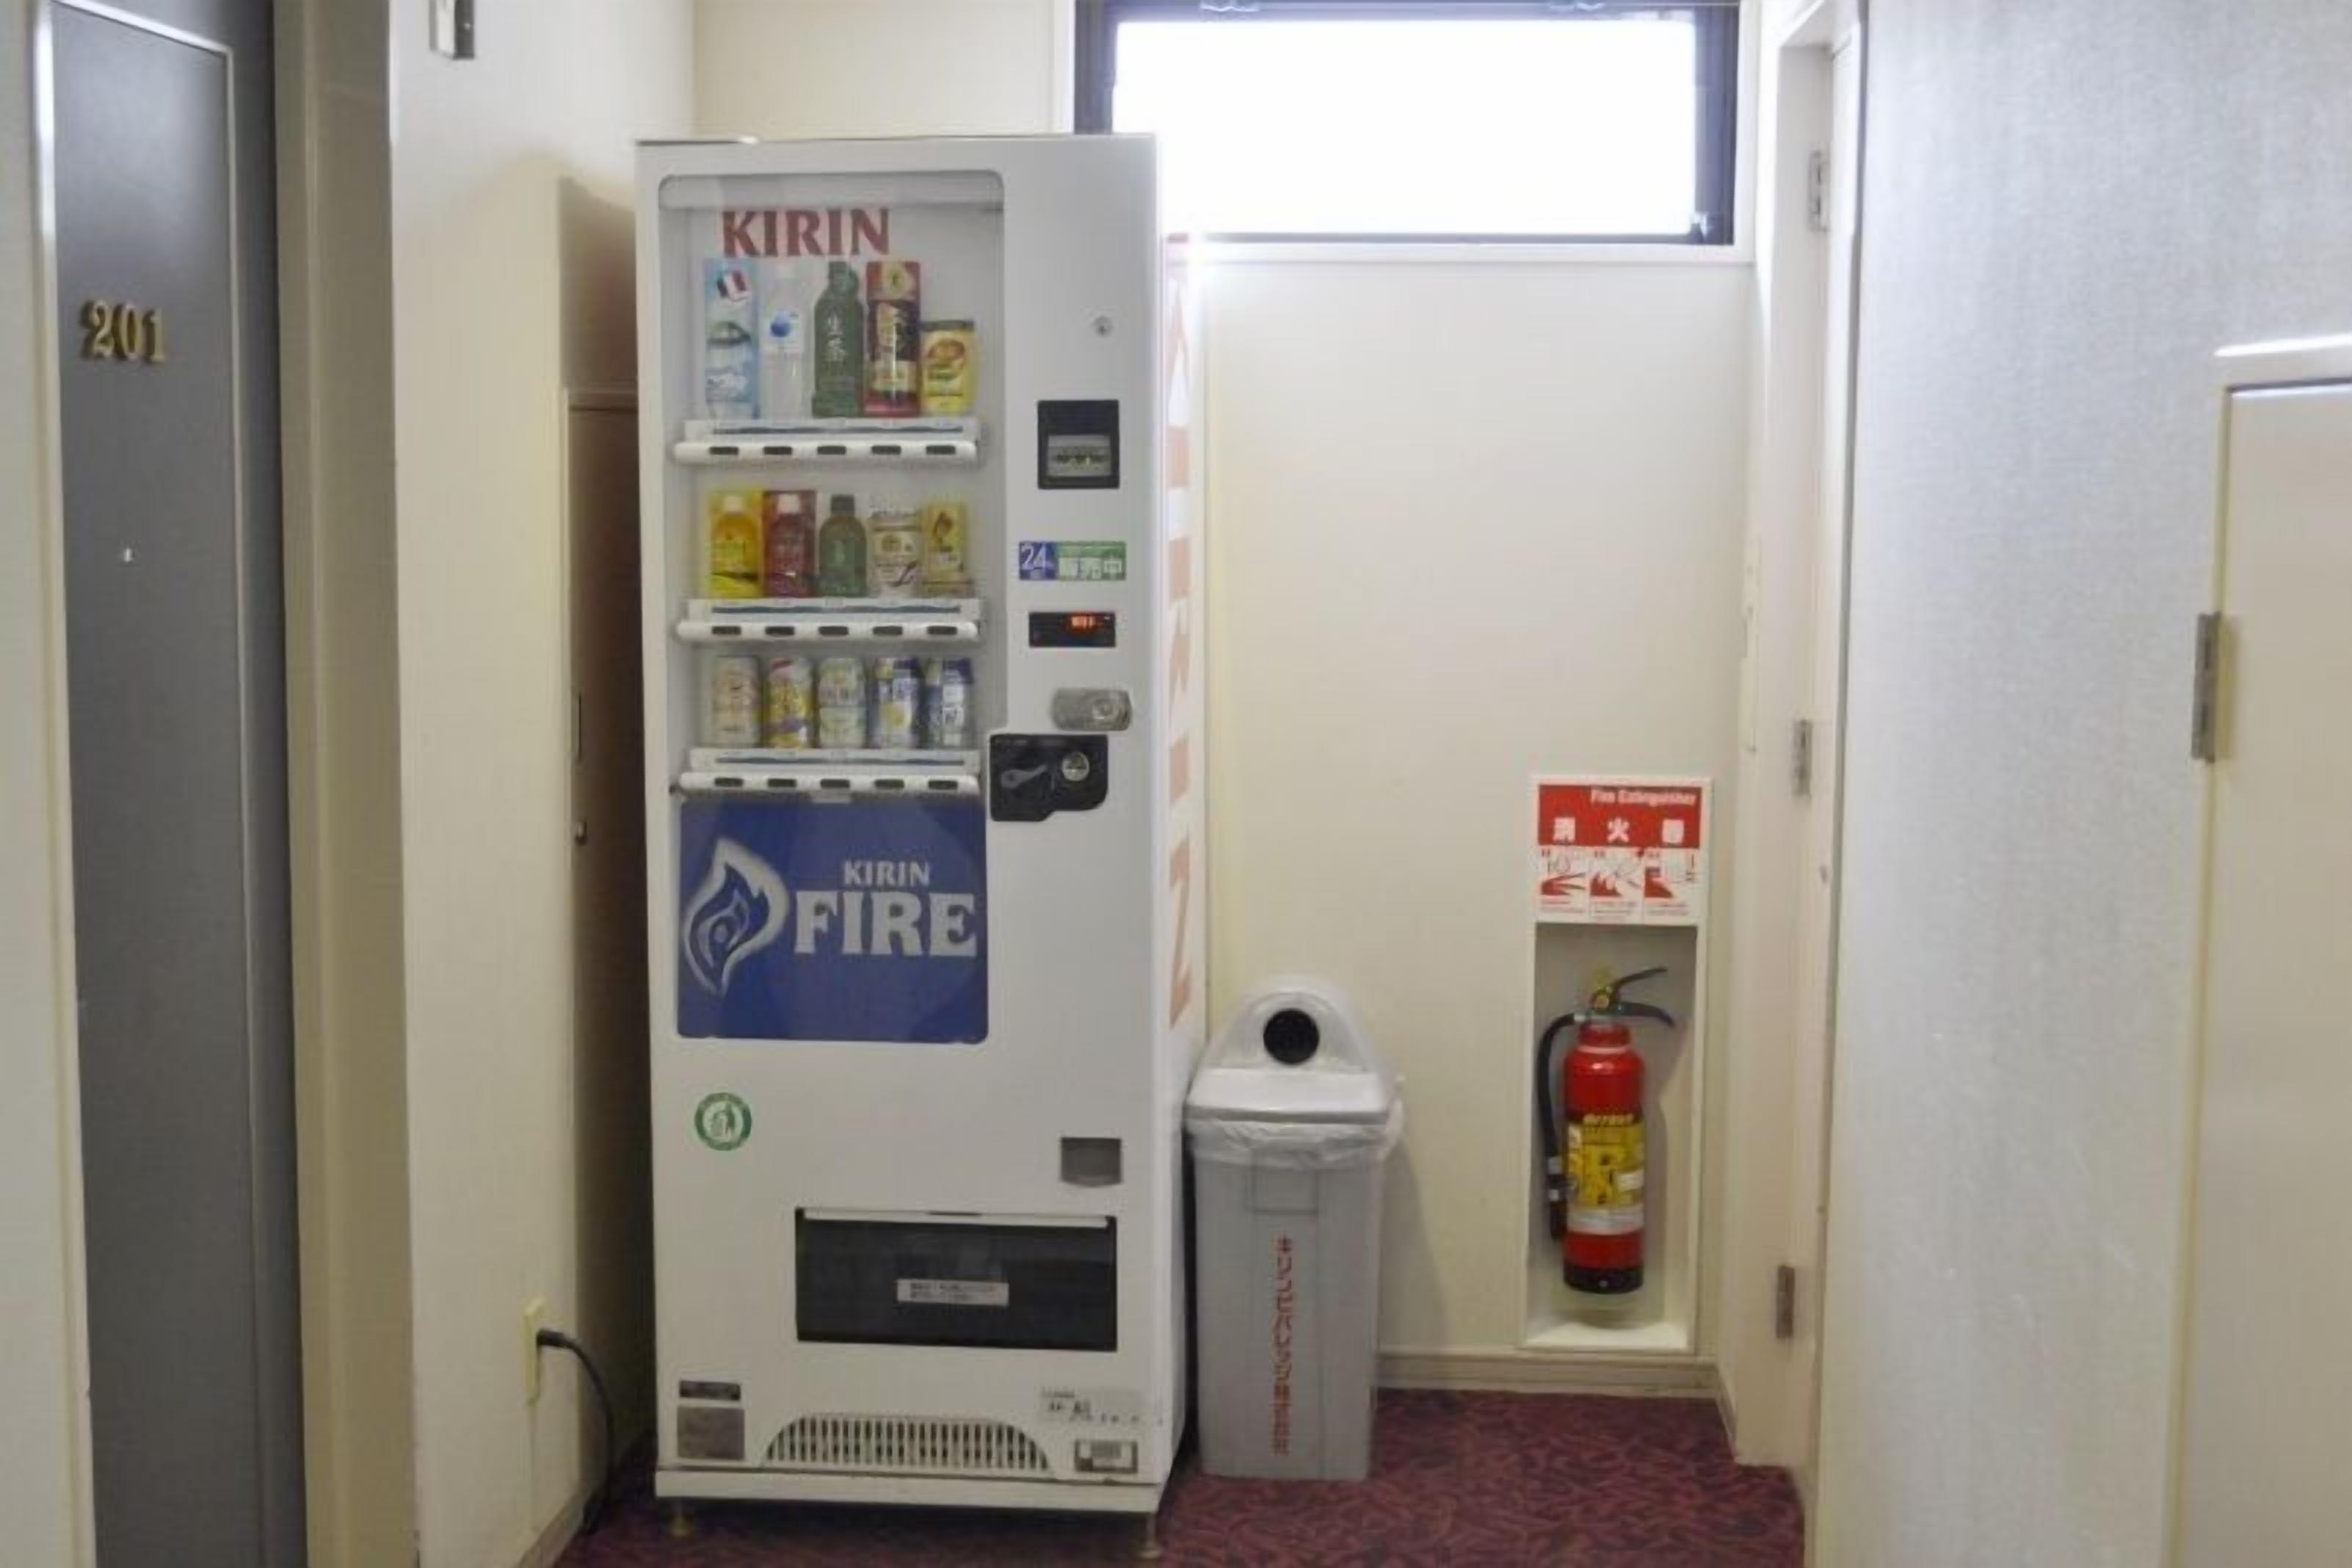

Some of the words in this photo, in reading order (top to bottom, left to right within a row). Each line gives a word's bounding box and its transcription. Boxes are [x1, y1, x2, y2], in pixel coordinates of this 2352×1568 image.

[722, 207, 889, 258] KIRIN
[82, 299, 166, 364] 201
[1020, 542, 1055, 571] 24
[843, 860, 931, 887] KIRIN
[794, 890, 978, 957] FIRE
